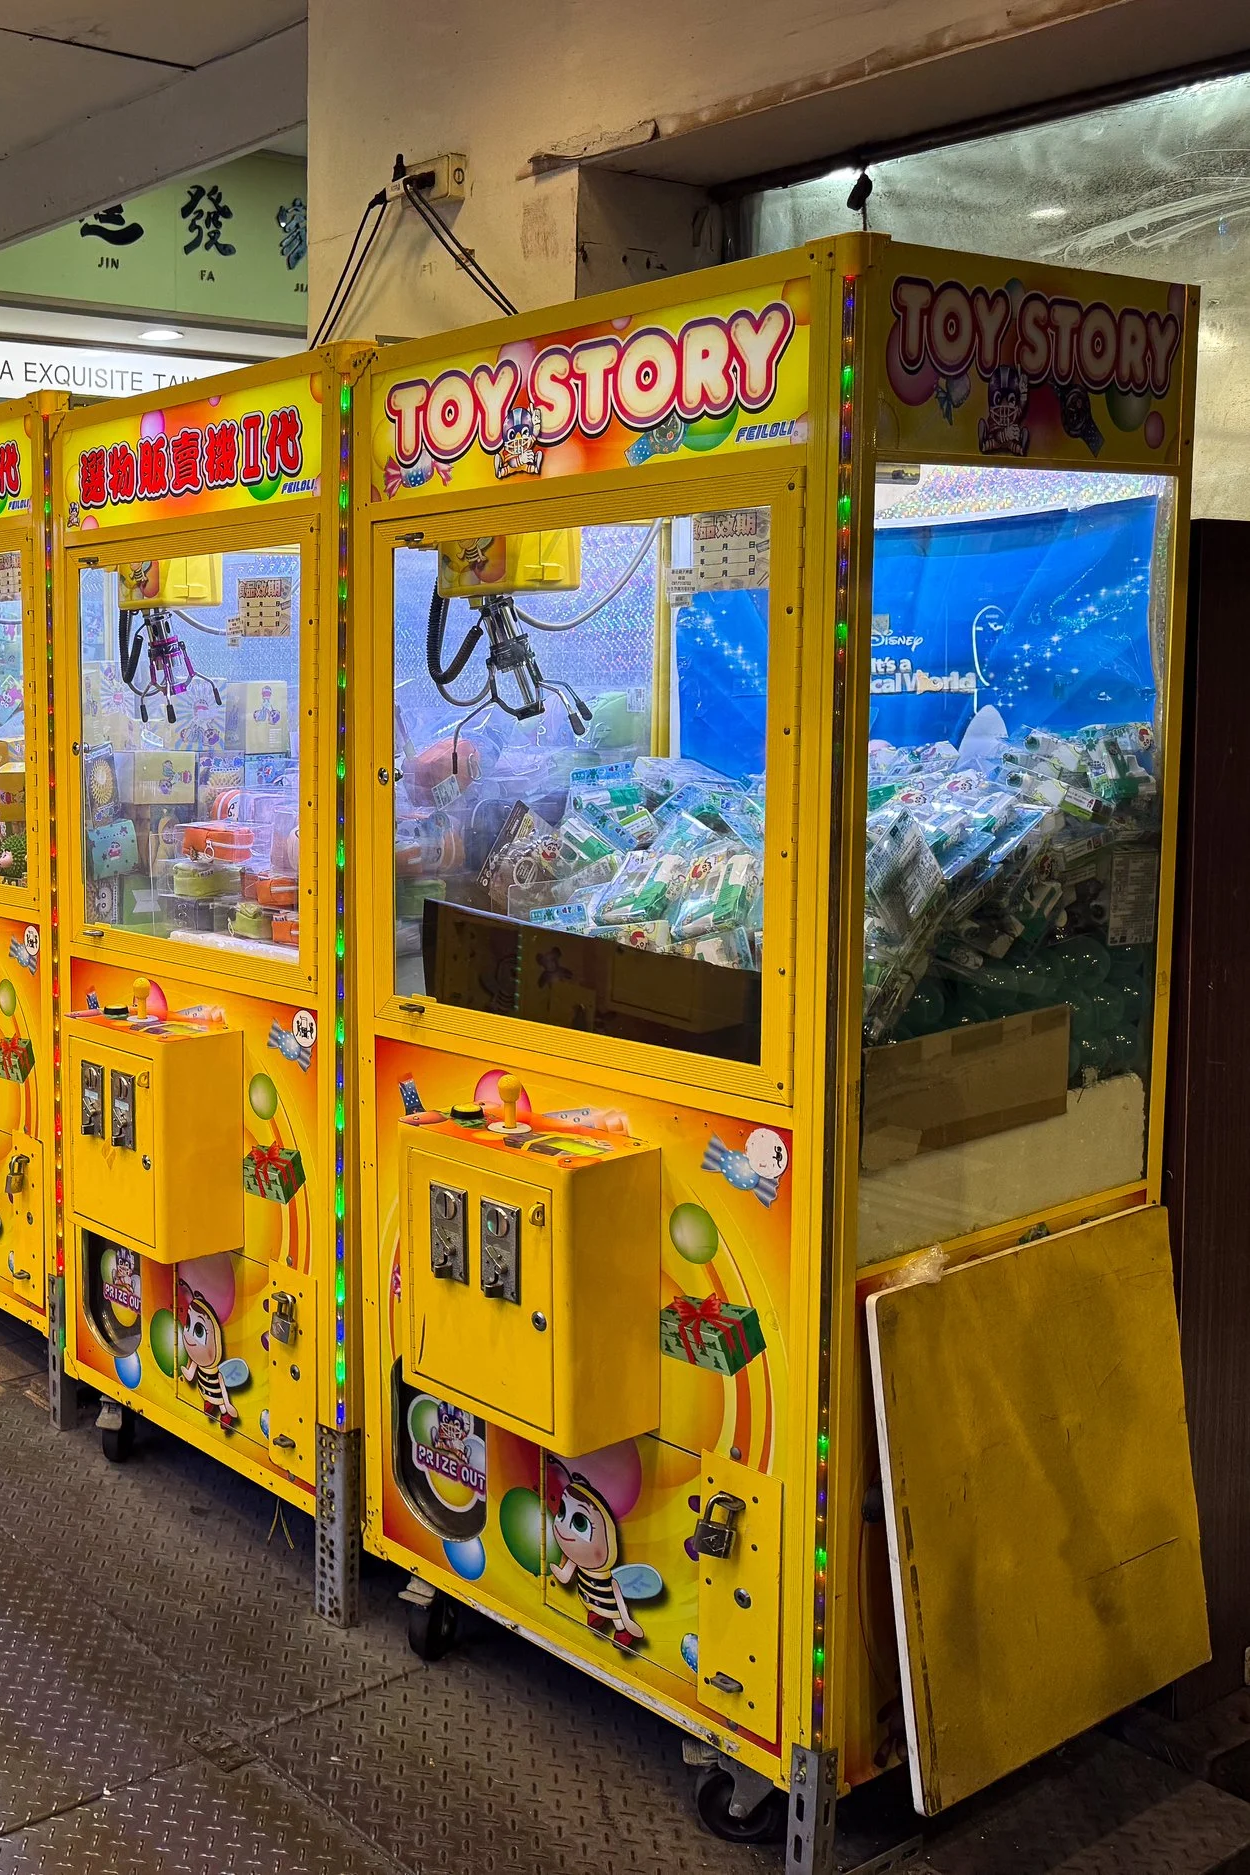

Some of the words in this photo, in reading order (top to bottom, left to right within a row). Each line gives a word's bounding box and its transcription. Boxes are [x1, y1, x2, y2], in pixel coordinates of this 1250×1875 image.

[98, 256, 120, 270] JIN
[200, 269, 215, 282] FA
[891, 275, 1012, 380] TOY
[1015, 291, 1180, 397] STORY
[24, 362, 143, 392] EXQUISITE
[385, 359, 522, 468] TOY
[528, 301, 796, 446] STORY
[735, 418, 796, 444] FEILOLI
[899, 657, 911, 673] a
[105, 1283, 128, 1305] PRIZE
[129, 1295, 142, 1311] OU
[417, 1444, 458, 1478] PRIZE
[461, 1466, 486, 1491] OUT
